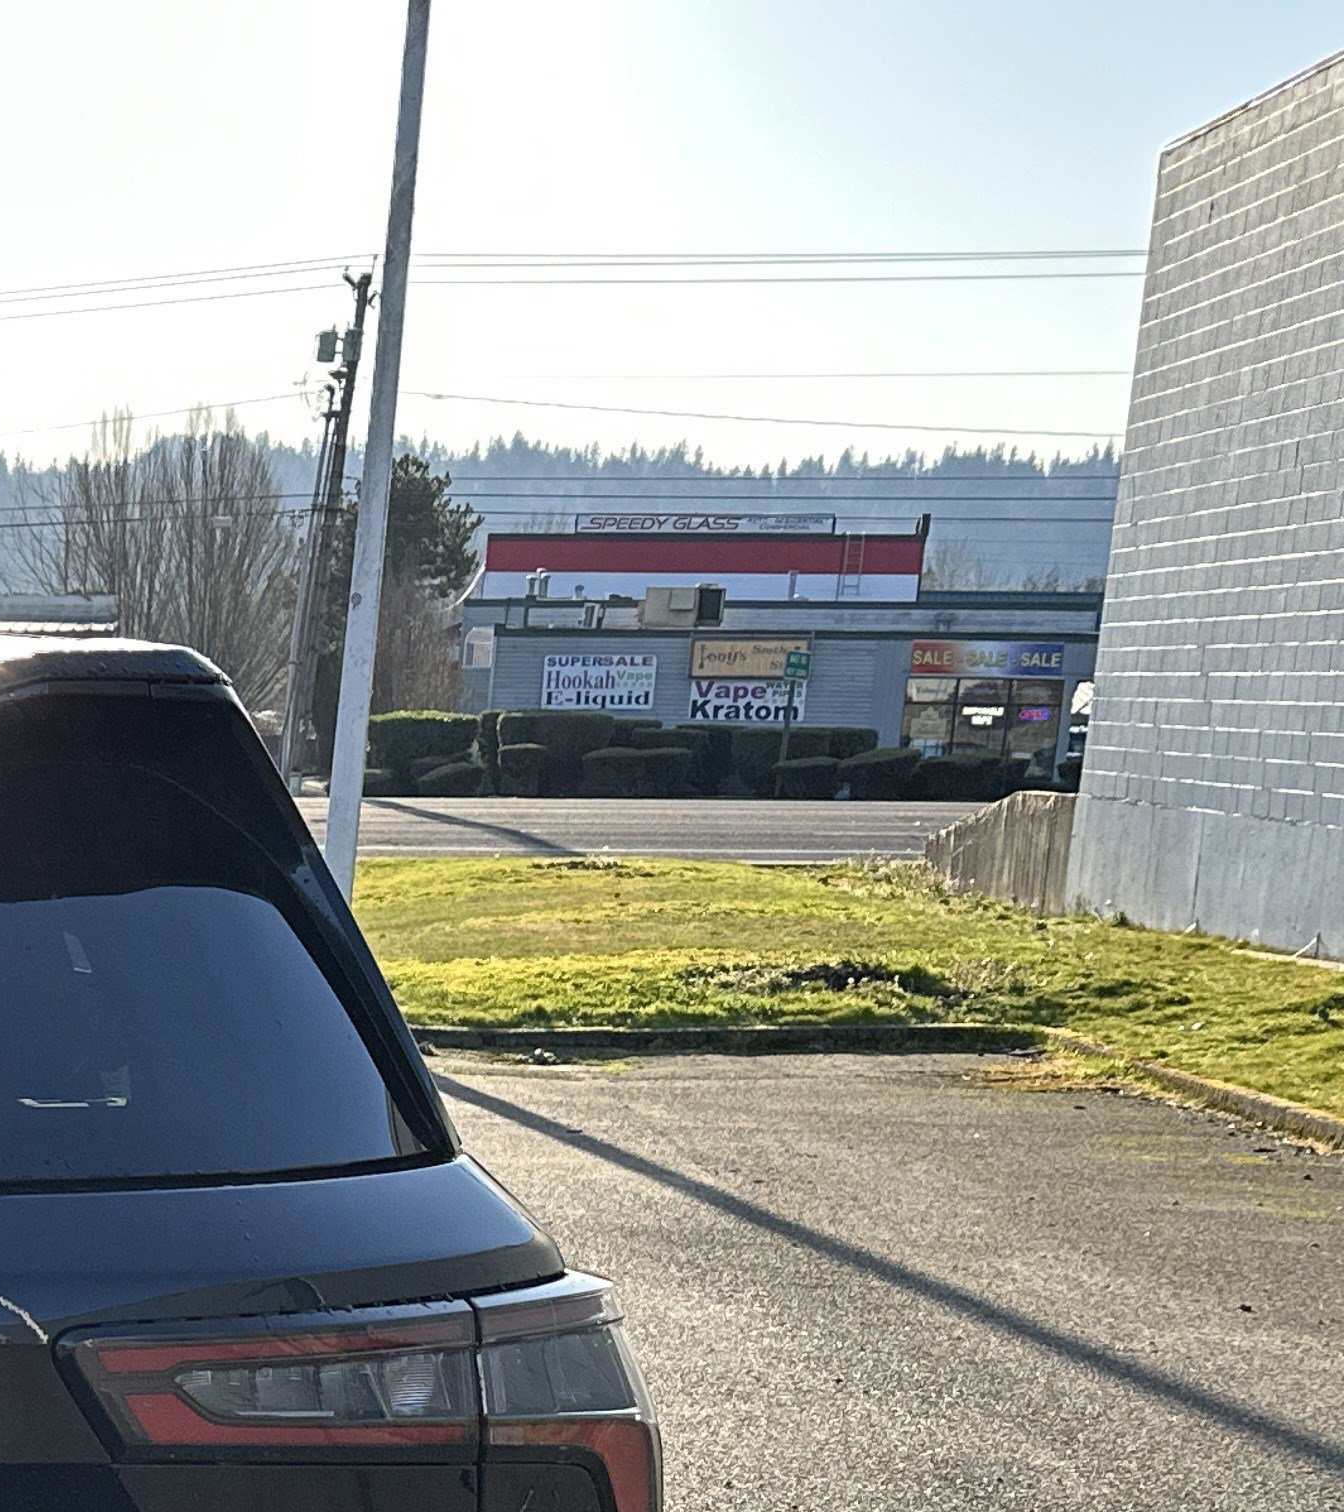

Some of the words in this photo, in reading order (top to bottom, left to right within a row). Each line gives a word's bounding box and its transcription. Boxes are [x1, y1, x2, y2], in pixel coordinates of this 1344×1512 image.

[580, 516, 670, 530] SPEEDY
[672, 516, 741, 530] GLASS
[913, 650, 953, 666] SALE
[967, 651, 1007, 667] SALE
[1020, 652, 1062, 668] SALE
[546, 669, 615, 689] Hookah
[544, 690, 650, 709] E-liquid
[694, 680, 767, 703] Vape
[689, 699, 799, 720] Kratom
